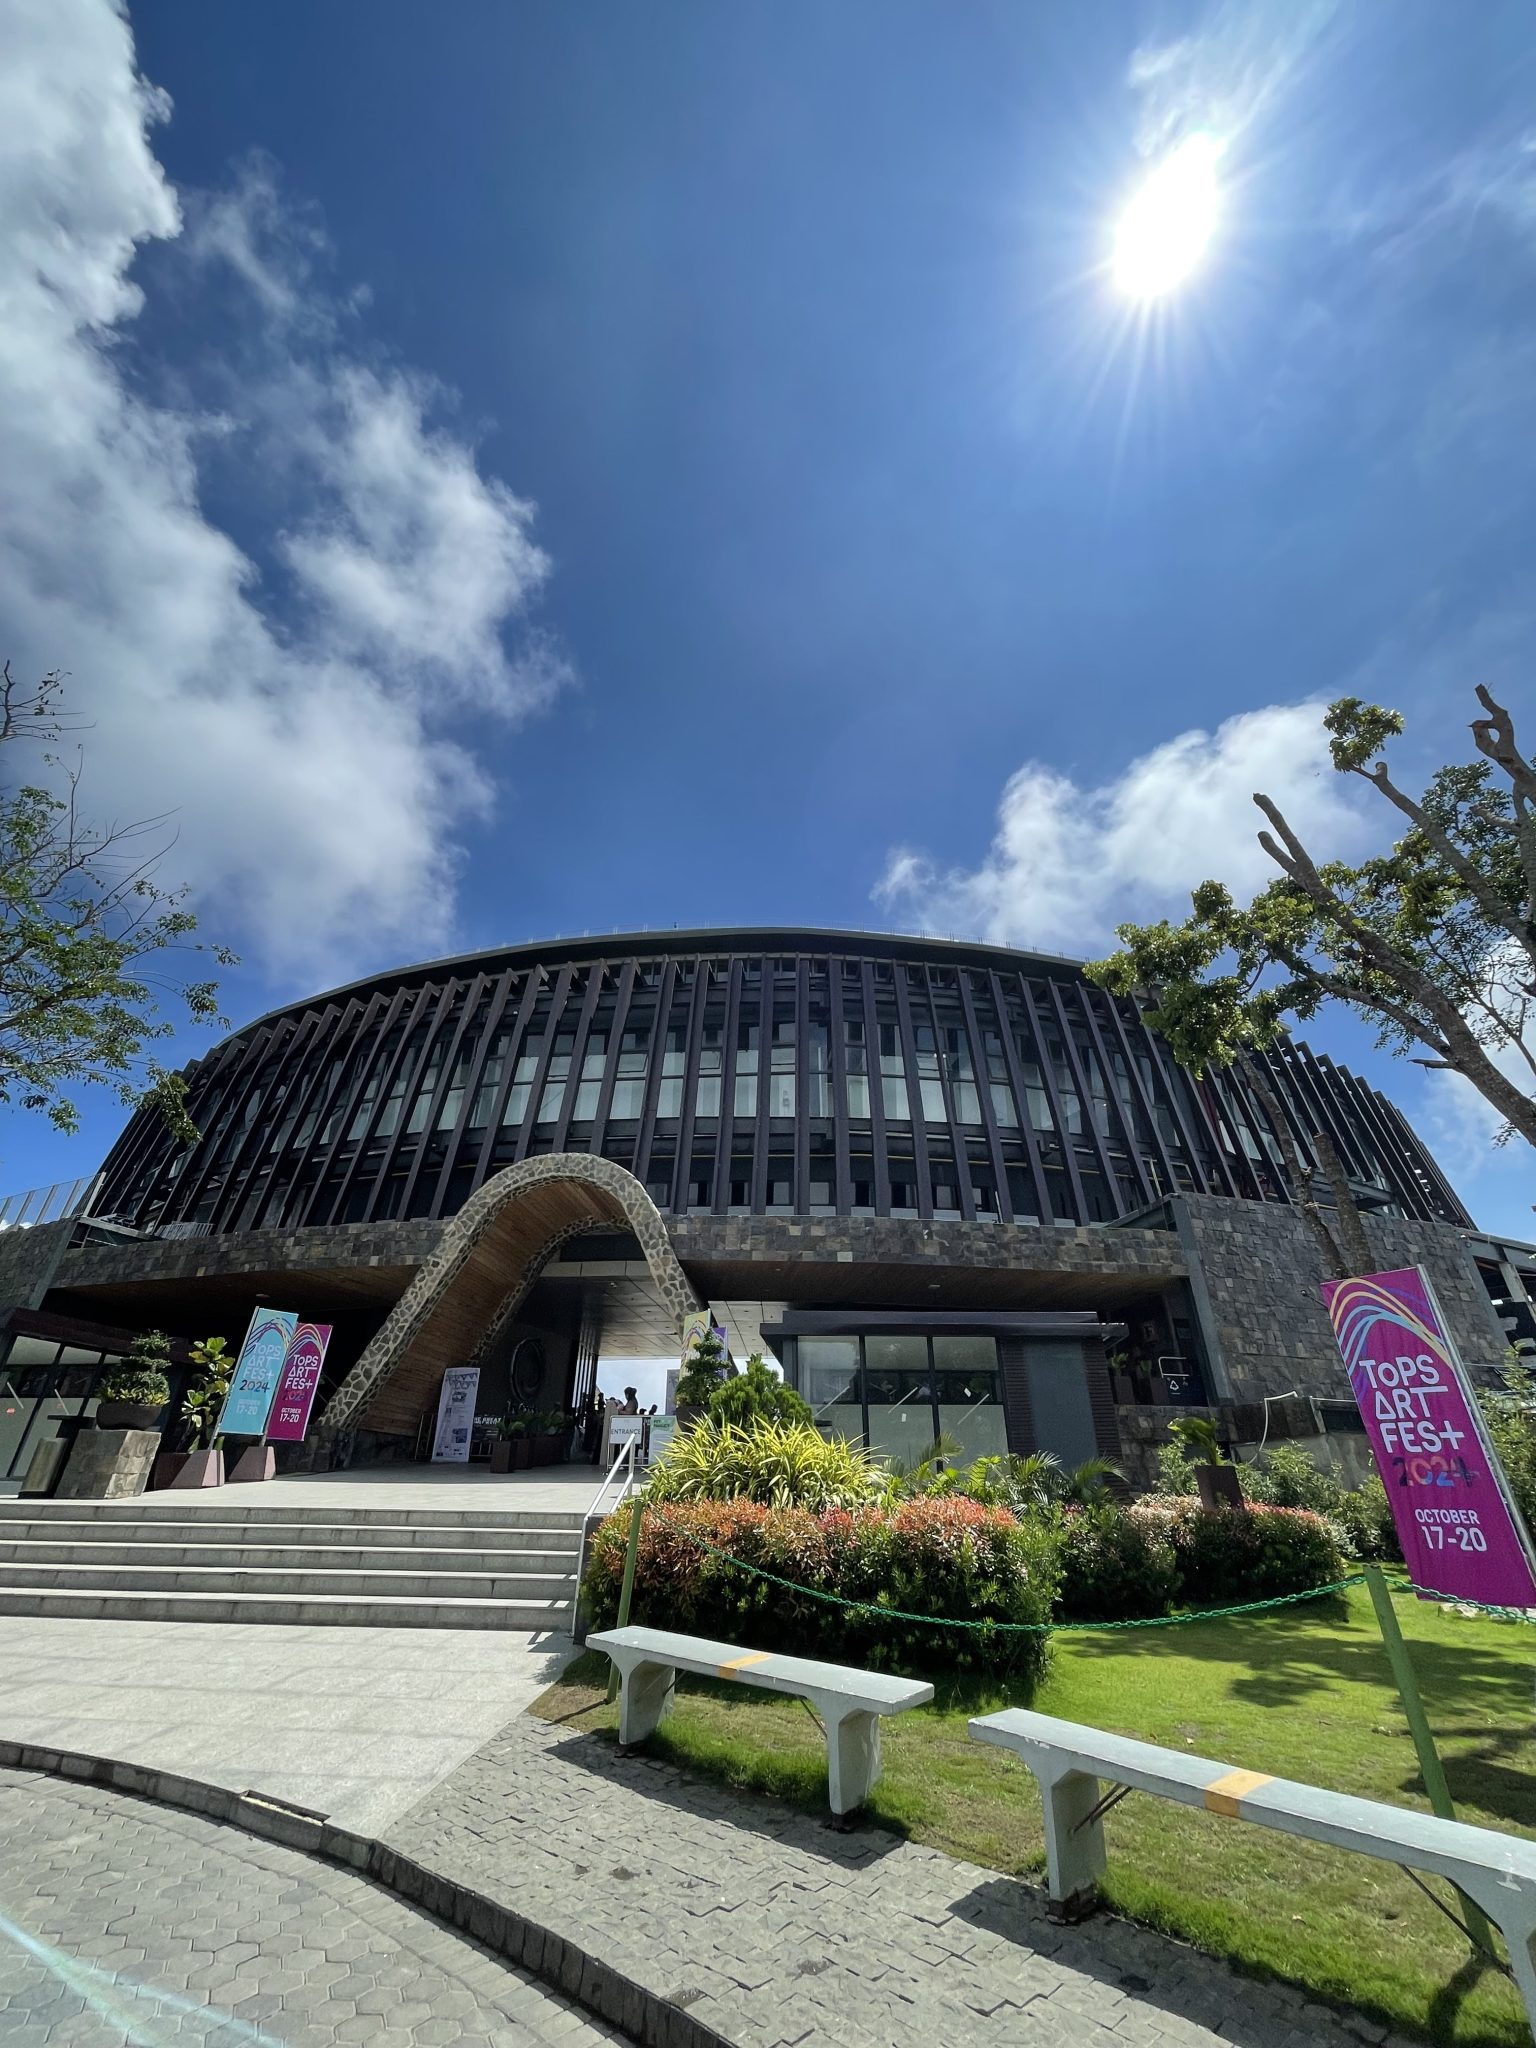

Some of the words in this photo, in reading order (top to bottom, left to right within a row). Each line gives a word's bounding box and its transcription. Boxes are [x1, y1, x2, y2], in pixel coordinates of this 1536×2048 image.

[253, 1343, 281, 1356] TOPS
[247, 1355, 280, 1368] ART
[293, 1354, 319, 1367] TOPS
[288, 1366, 317, 1378] ART
[1359, 1354, 1440, 1389] TOPS
[240, 1380, 270, 1393] 2024
[1375, 1385, 1449, 1420] ART
[279, 1413, 299, 1423] 17-20
[1392, 1456, 1480, 1487] 2024
[1414, 1509, 1481, 1525] OCTOBER
[1421, 1526, 1488, 1552] 17-20
